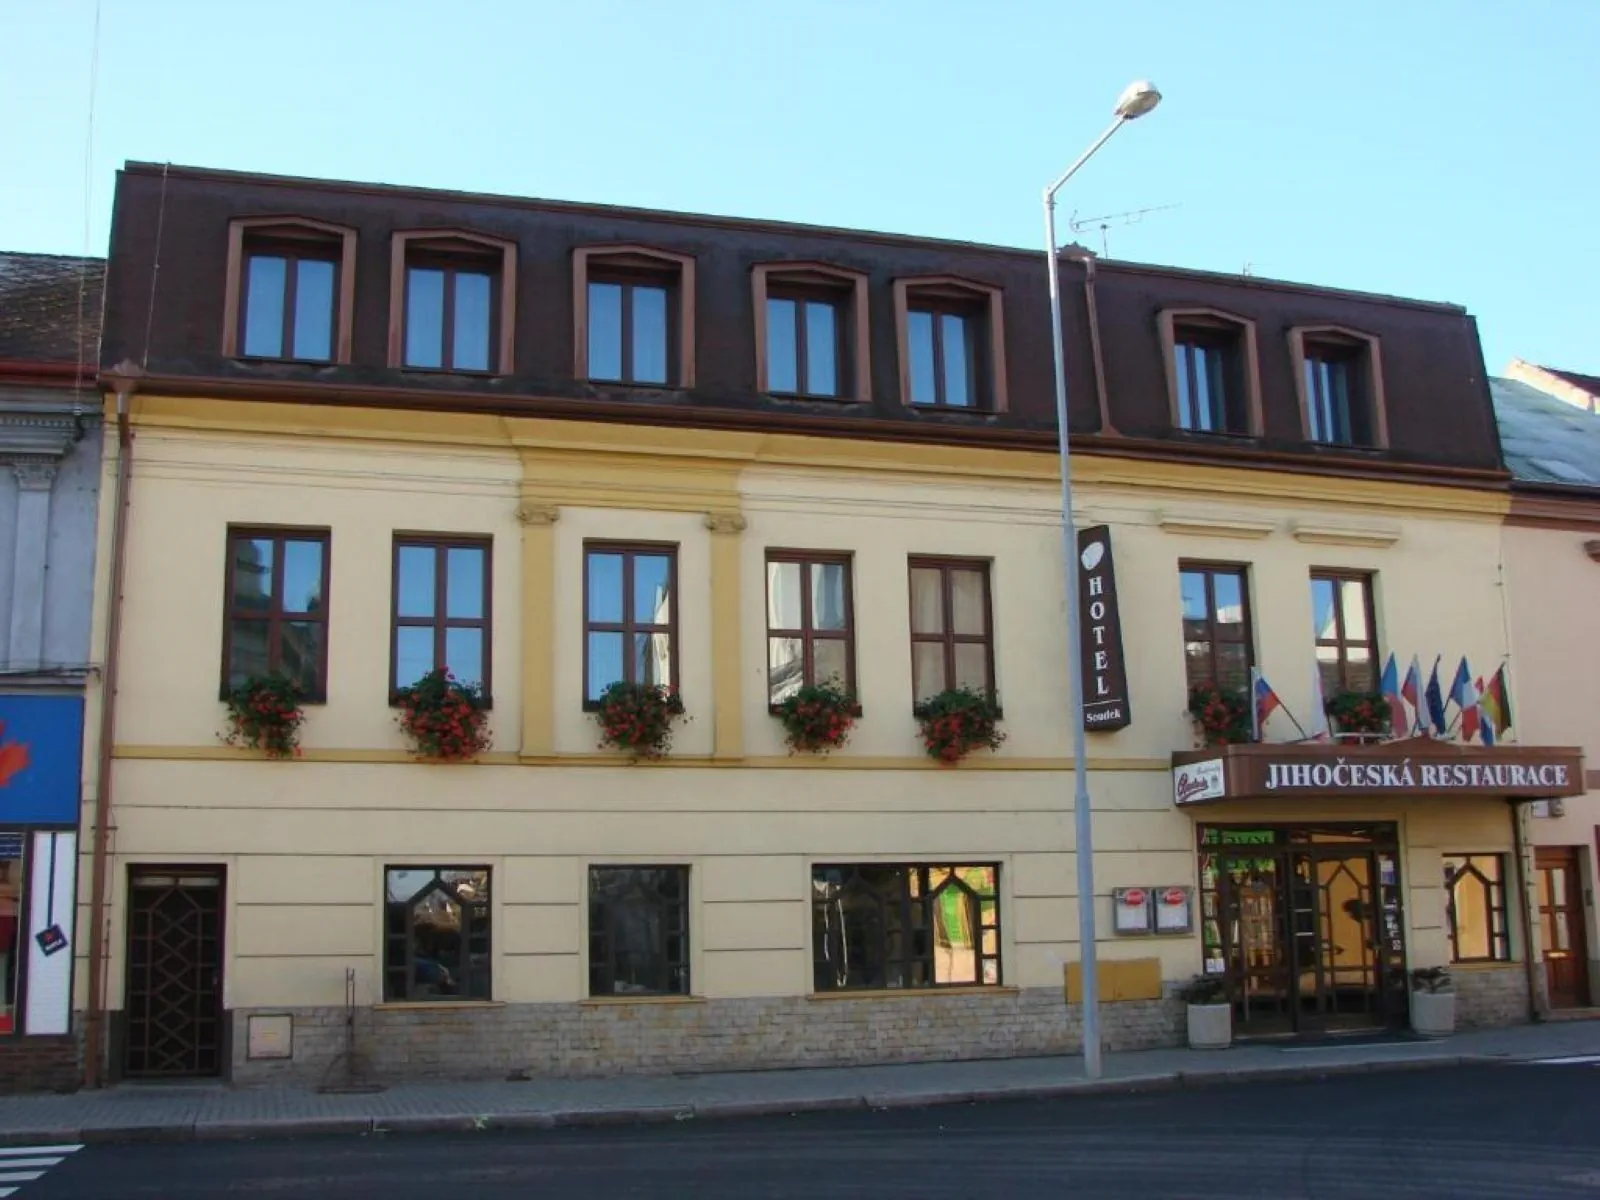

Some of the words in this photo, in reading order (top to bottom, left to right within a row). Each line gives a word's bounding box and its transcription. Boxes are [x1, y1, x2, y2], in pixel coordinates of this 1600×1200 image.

[1088, 575, 1109, 695] HOTEL
[1265, 756, 1415, 789] JIHOČESKÁ
[1420, 764, 1569, 786] RESTAURACE
